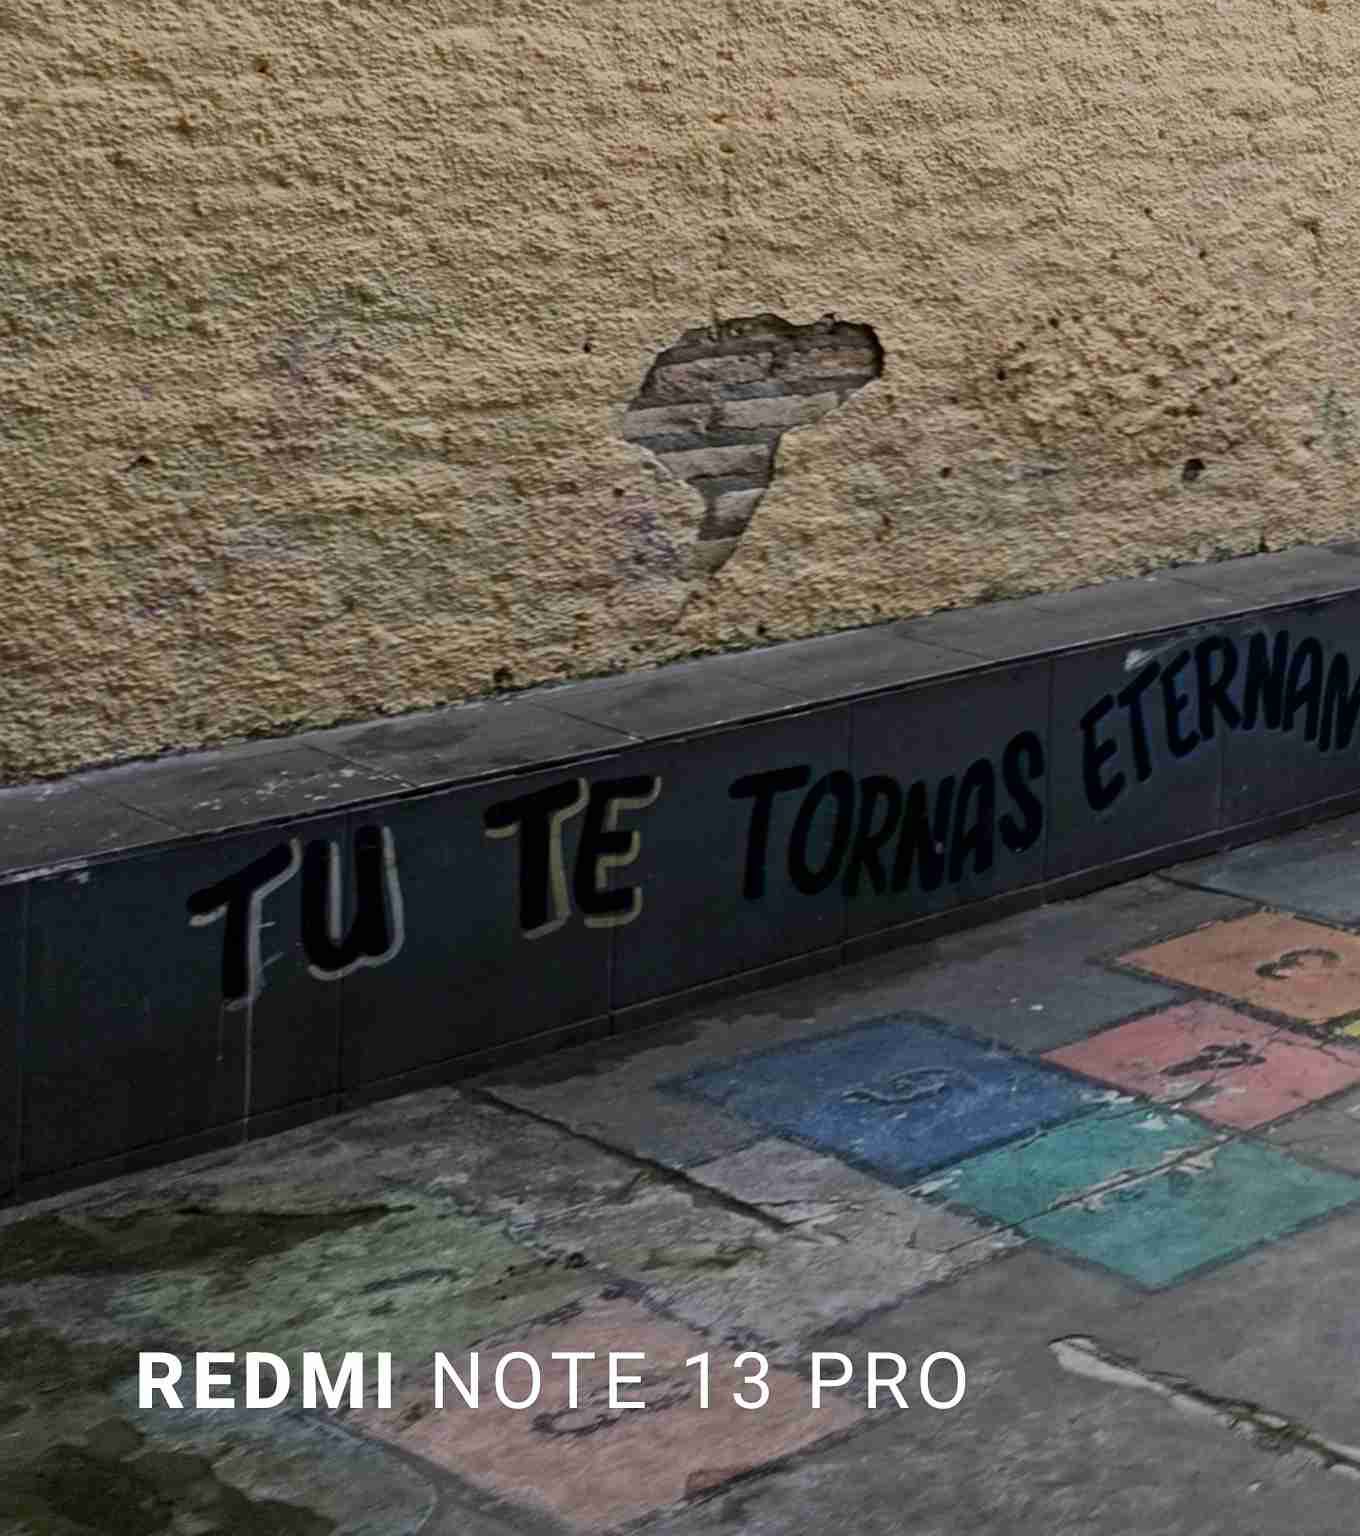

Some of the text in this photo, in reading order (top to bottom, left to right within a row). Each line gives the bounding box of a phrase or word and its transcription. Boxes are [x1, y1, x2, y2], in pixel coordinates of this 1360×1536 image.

[186, 824, 404, 1011] TU
[484, 775, 662, 940] TE
[729, 728, 1047, 901] TORNAS
